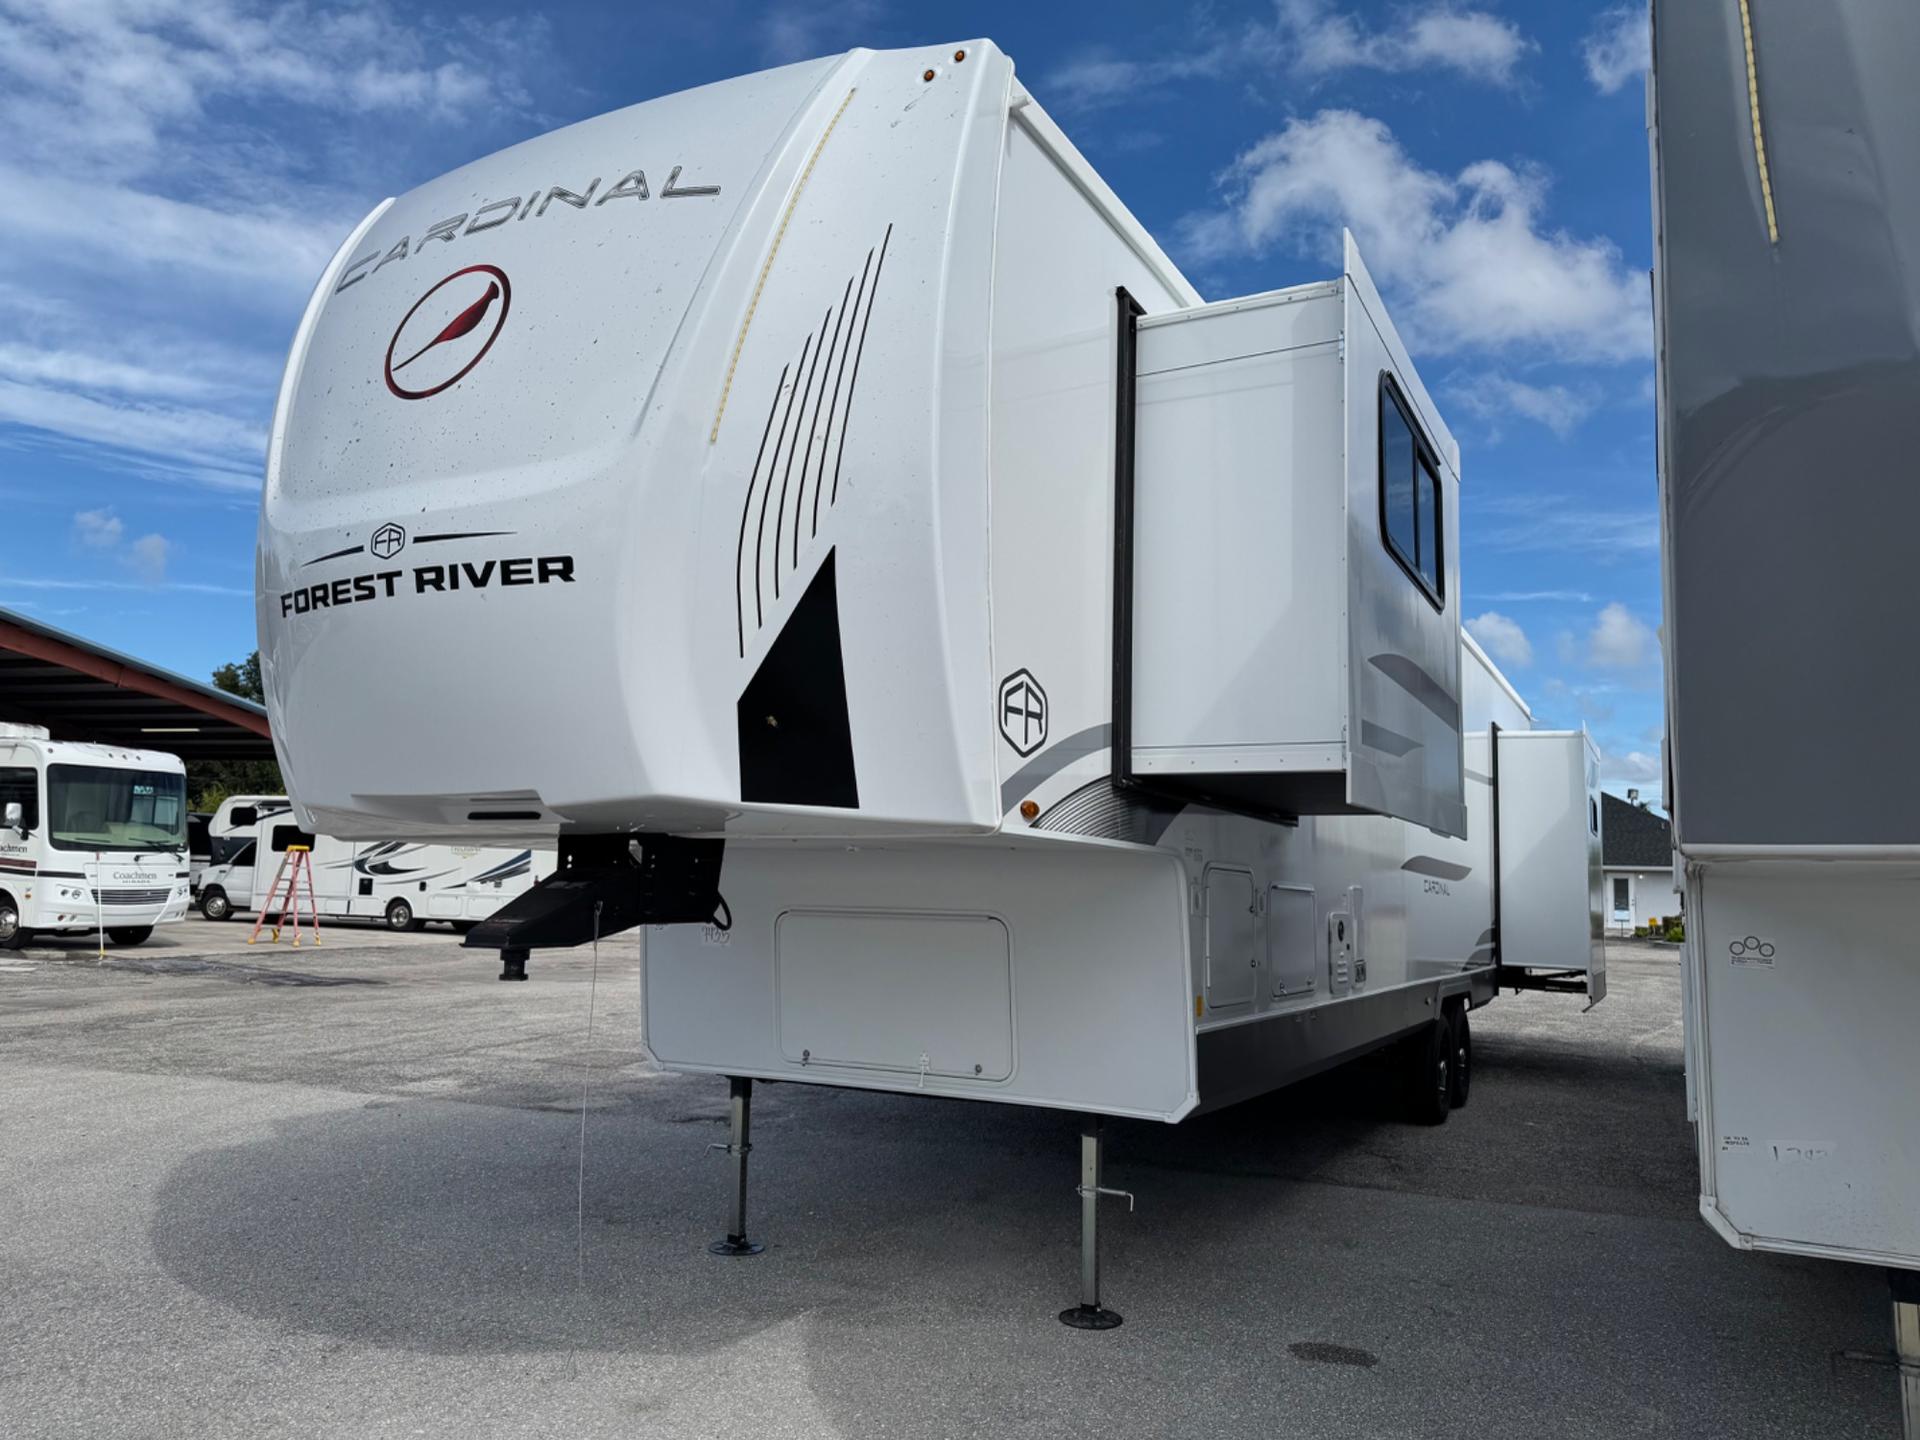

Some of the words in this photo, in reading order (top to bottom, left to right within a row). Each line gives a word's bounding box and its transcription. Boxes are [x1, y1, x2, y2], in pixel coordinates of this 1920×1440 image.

[335, 165, 721, 295] CARDINAL
[280, 570, 404, 618] FOREST
[413, 555, 577, 594] RIVER
[113, 871, 158, 880] Coachmen
